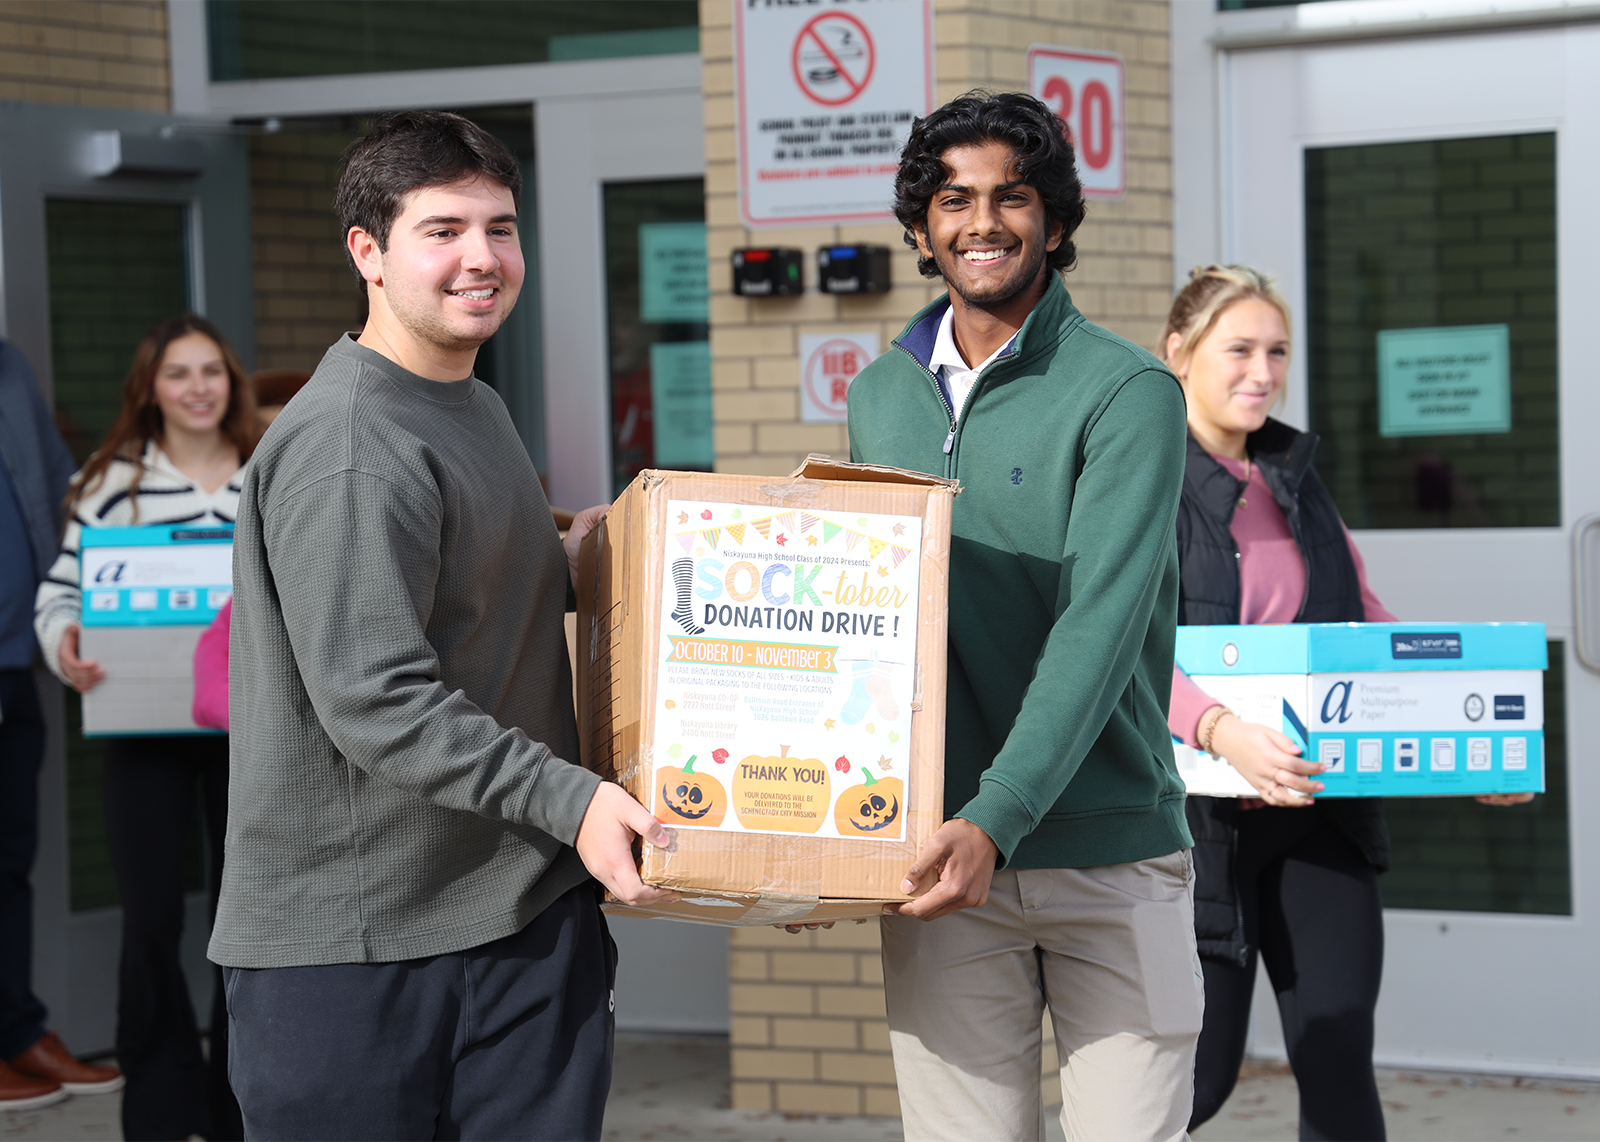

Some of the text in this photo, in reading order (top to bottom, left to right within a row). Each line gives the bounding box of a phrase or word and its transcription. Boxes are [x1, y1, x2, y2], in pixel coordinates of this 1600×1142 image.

[1042, 76, 1111, 168] 30
[723, 550, 756, 560] Niskayuna
[758, 552, 772, 562] High
[774, 553, 795, 562] School
[797, 554, 813, 563] Class
[840, 558, 871, 567] Presents:
[704, 604, 813, 631] DONATION
[822, 611, 885, 636] DRIVE
[675, 640, 728, 662] OCTOBER
[732, 644, 744, 663] 10
[824, 651, 831, 670] 3
[668, 666, 689, 674] PLEASE
[691, 667, 709, 675] BRING
[711, 668, 725, 676] NEW
[727, 669, 745, 678] SOCKS
[747, 670, 755, 678] OF
[768, 672, 784, 681] SIZES
[790, 674, 804, 682] KIDS
[811, 675, 833, 684] ADULTS
[677, 677, 704, 686] ORIGINAL
[706, 678, 739, 688] PACKAGING
[751, 682, 761, 690] THE
[763, 682, 798, 692] FOLLOWING
[800, 685, 832, 694] LOCATIONS
[1361, 684, 1399, 693] Premium
[1321, 681, 1353, 724] a
[1361, 697, 1418, 708] Multipurpose
[1361, 710, 1385, 720] Paper
[741, 764, 825, 785] THANK YOU!
[744, 791, 759, 799] YOUR
[760, 792, 791, 801] DONATIONS
[793, 794, 805, 802] WILL
[741, 807, 817, 818] SCHENECTADY CITY MISSION
[785, 801, 791, 809] TO
[793, 802, 802, 810] THE
